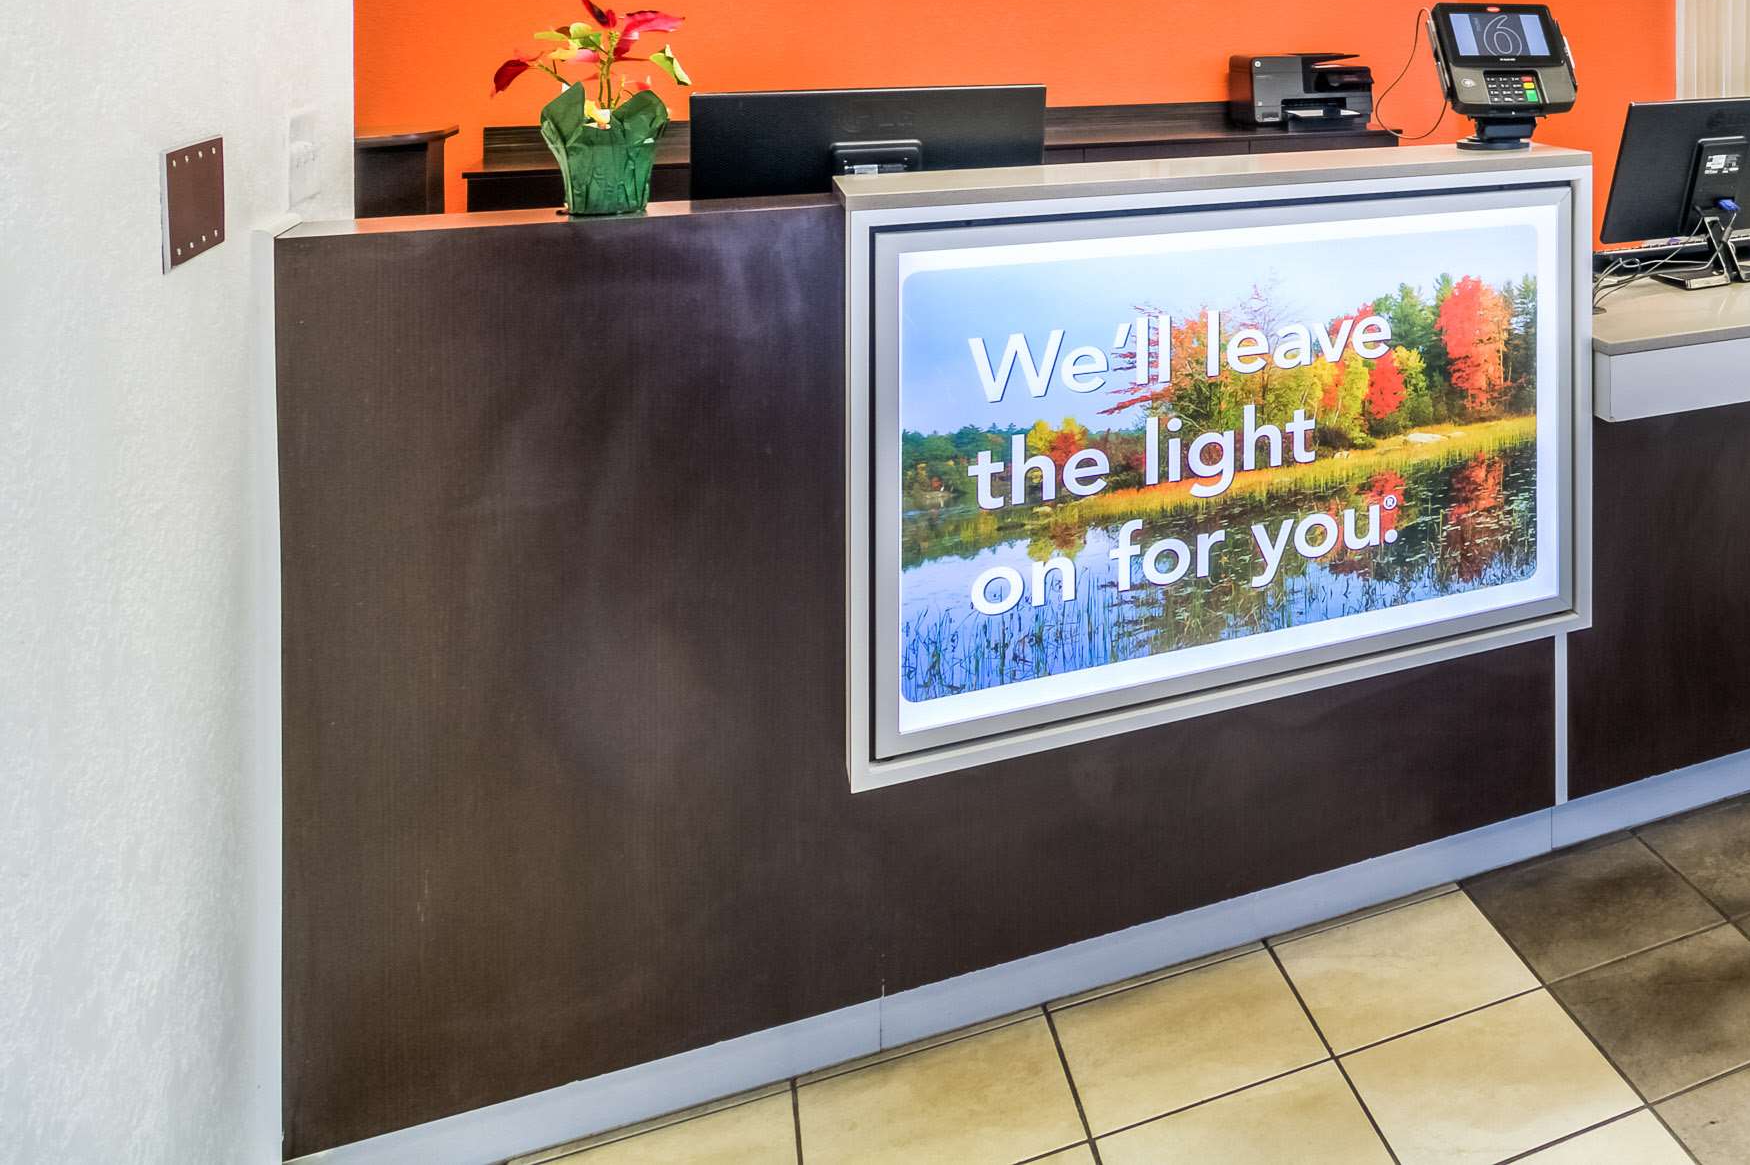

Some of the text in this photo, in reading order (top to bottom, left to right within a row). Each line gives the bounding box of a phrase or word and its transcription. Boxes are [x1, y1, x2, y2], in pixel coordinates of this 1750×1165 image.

[1483, 15, 1523, 56] 6
[1205, 309, 1393, 378] leave
[967, 404, 1317, 510] the light
[970, 556, 1076, 616] on
[1109, 518, 1226, 592] for
